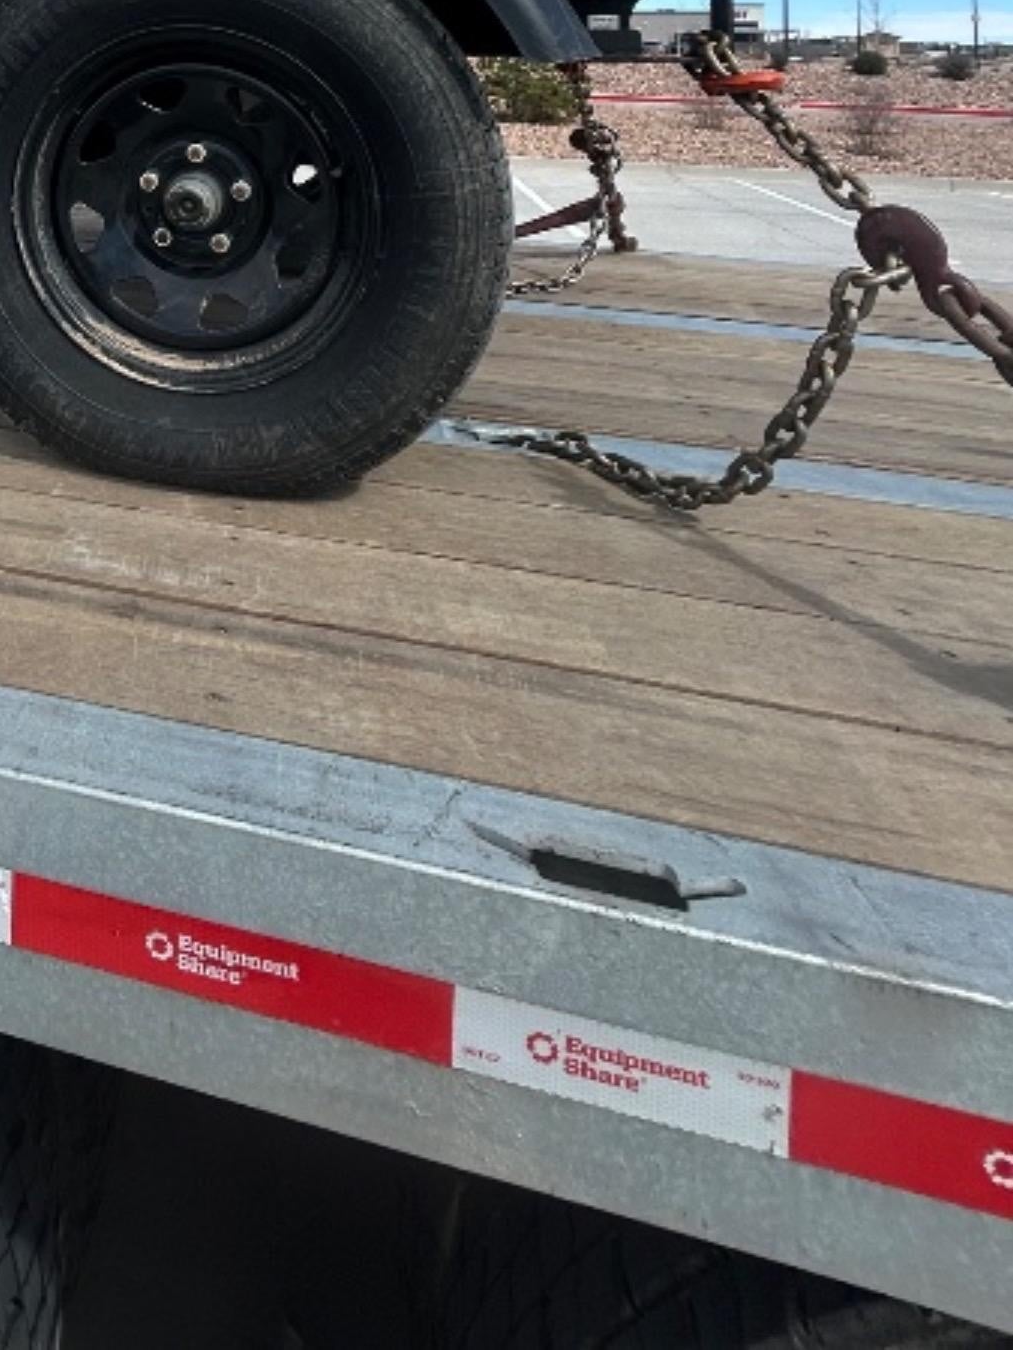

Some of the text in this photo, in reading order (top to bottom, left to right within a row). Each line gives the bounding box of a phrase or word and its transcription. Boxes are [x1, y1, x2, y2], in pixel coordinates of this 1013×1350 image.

[178, 934, 299, 981] Equipment
[563, 1057, 639, 1093] Share
[565, 1034, 710, 1090] Equipment
